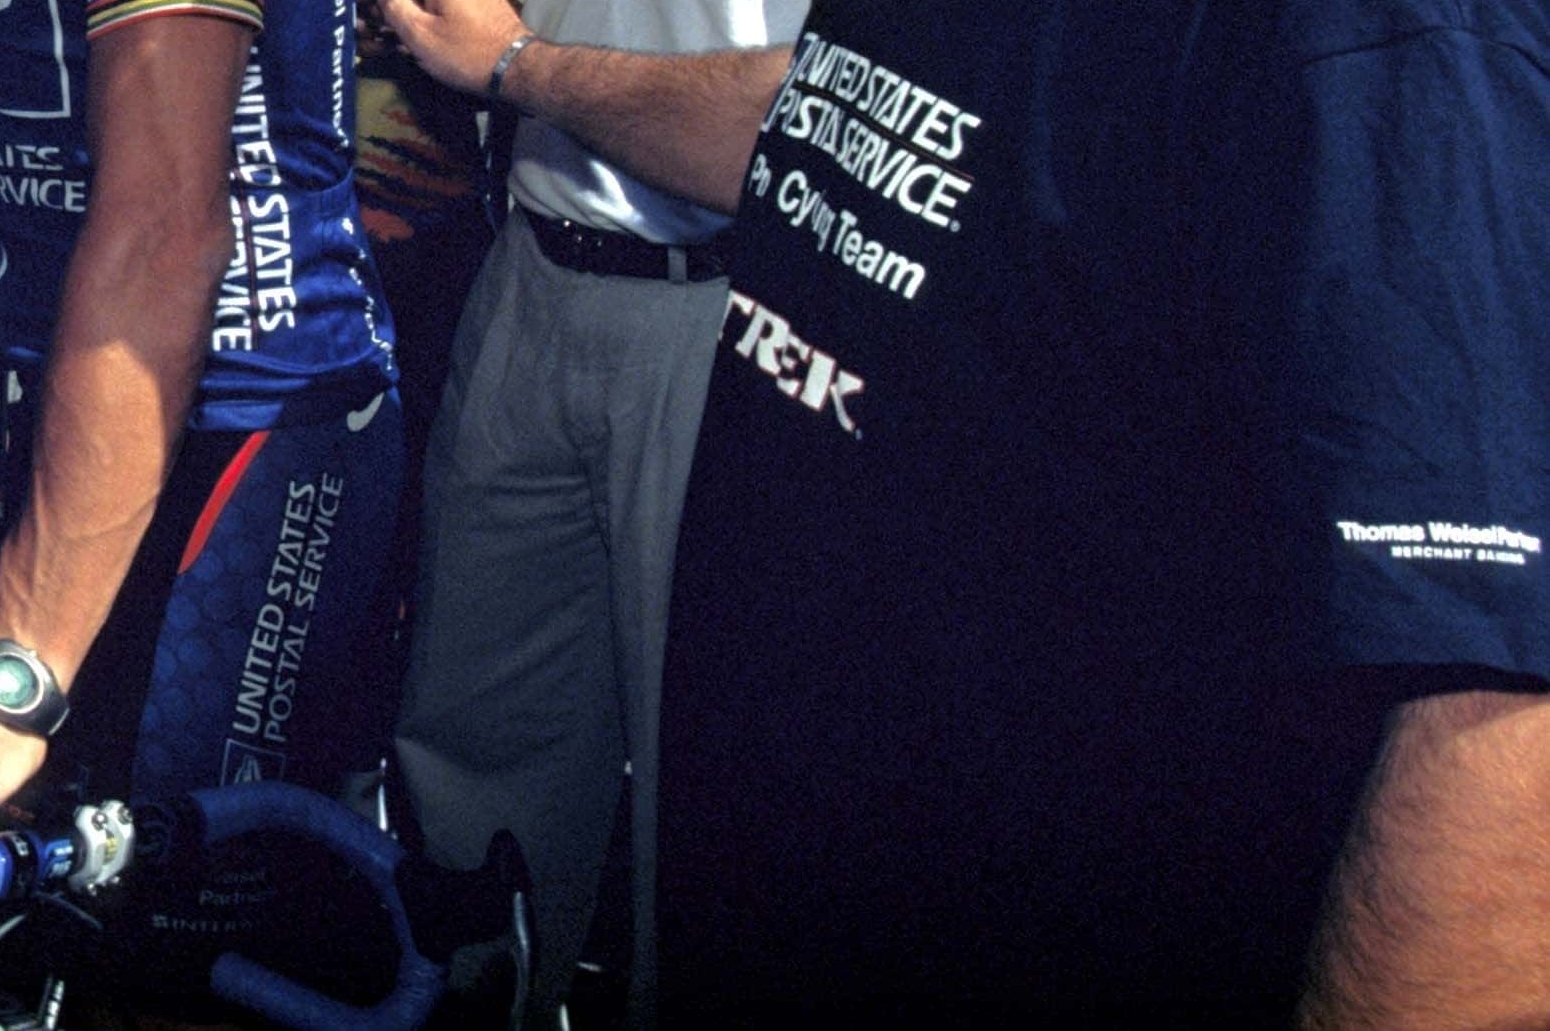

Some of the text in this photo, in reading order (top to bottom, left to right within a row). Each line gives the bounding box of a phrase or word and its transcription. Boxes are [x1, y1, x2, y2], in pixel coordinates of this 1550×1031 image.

[857, 65, 982, 161] STATES
[835, 118, 973, 228] SERVICE
[248, 193, 297, 332] STATES
[833, 209, 926, 300] Team
[1337, 521, 1425, 542] Thomas
[1428, 521, 1497, 544] Weisel
[232, 480, 316, 734] UNITED STATES
[264, 472, 343, 743] POSTAL SERVICE
